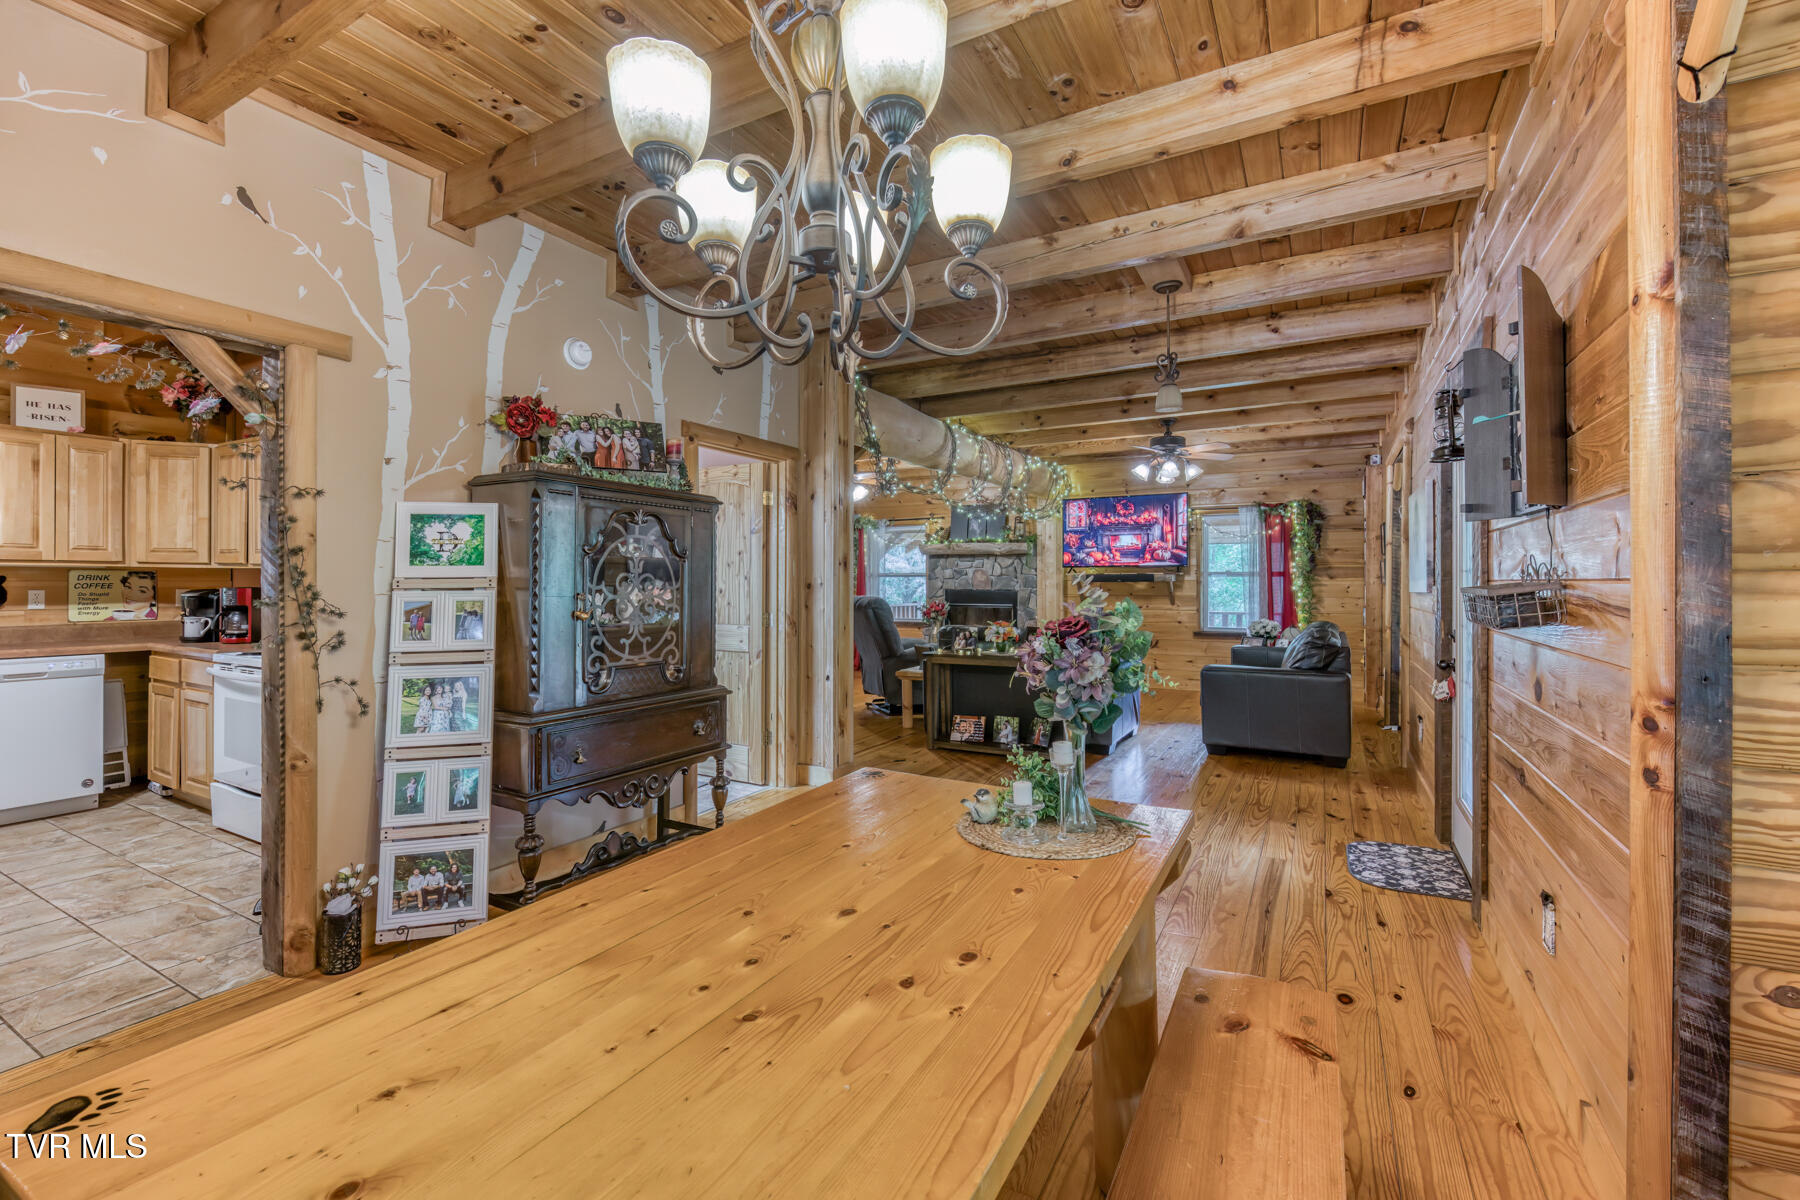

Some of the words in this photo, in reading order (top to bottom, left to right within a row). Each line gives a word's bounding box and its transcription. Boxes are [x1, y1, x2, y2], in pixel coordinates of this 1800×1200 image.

[25, 400, 42, 408] HE
[47, 402, 72, 411] HAS
[77, 574, 111, 582] DRINK
[73, 582, 114, 590] COFFEE
